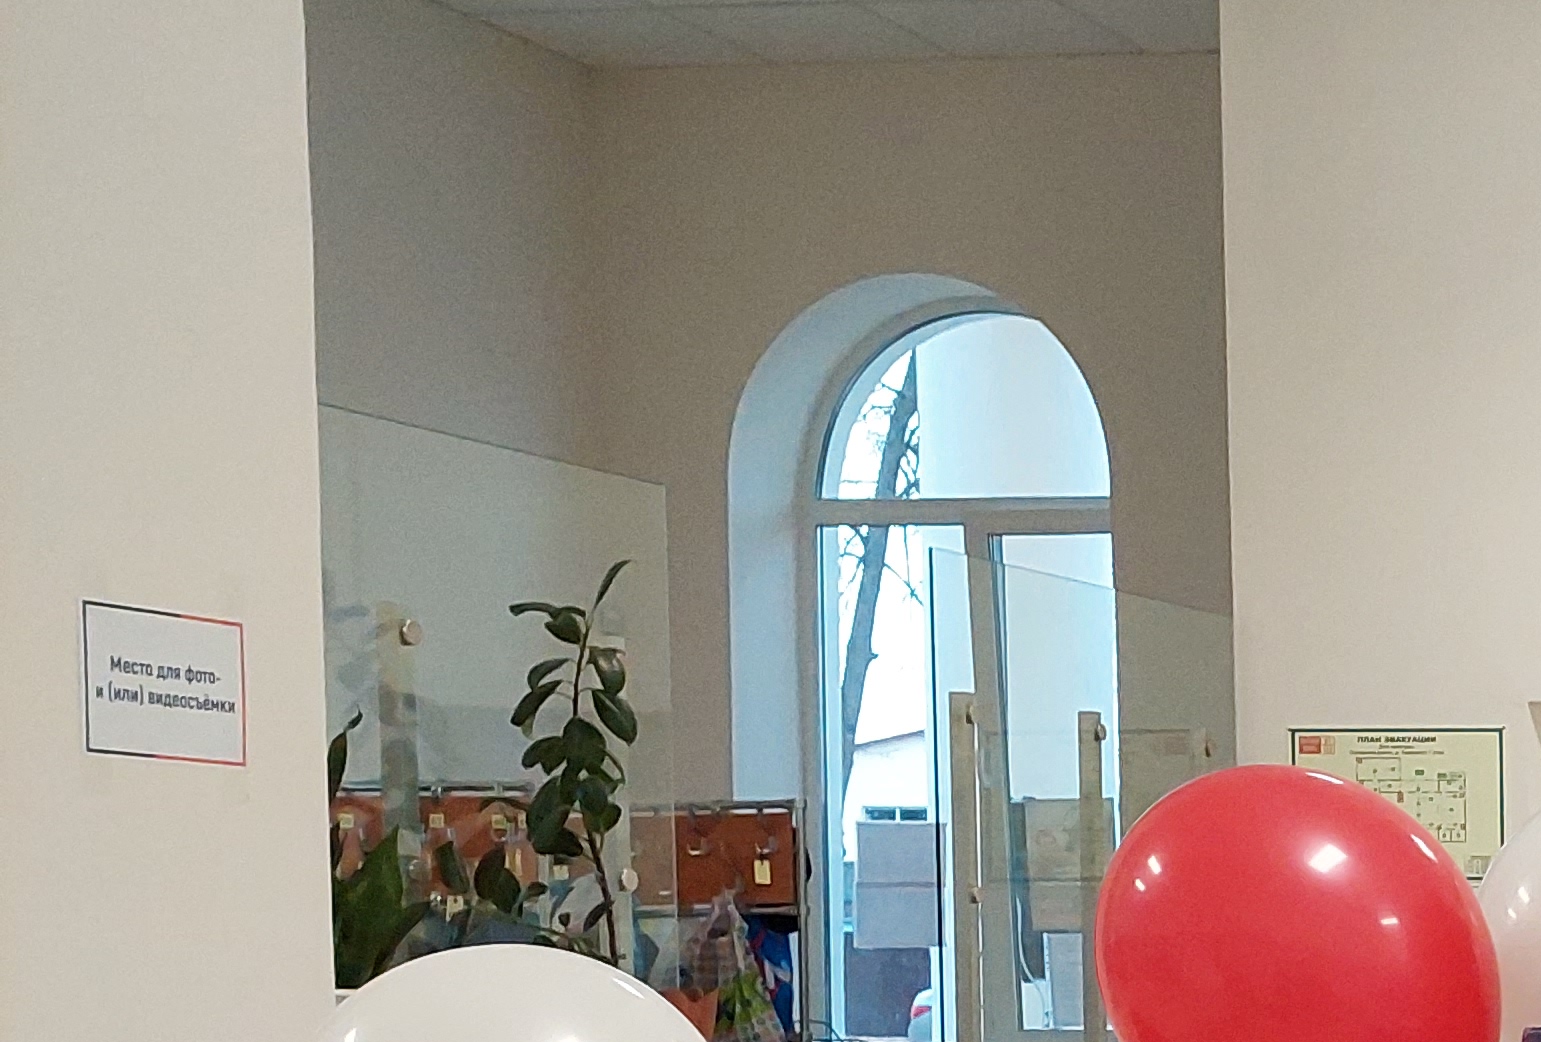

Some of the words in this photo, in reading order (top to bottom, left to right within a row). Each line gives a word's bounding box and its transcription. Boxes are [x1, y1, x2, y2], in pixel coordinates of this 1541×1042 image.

[109, 655, 153, 677] Место
[156, 666, 181, 681] для
[185, 664, 221, 685] фото-
[95, 685, 104, 699] и
[108, 680, 144, 706] (или)
[148, 690, 236, 714] видеосъёмки
